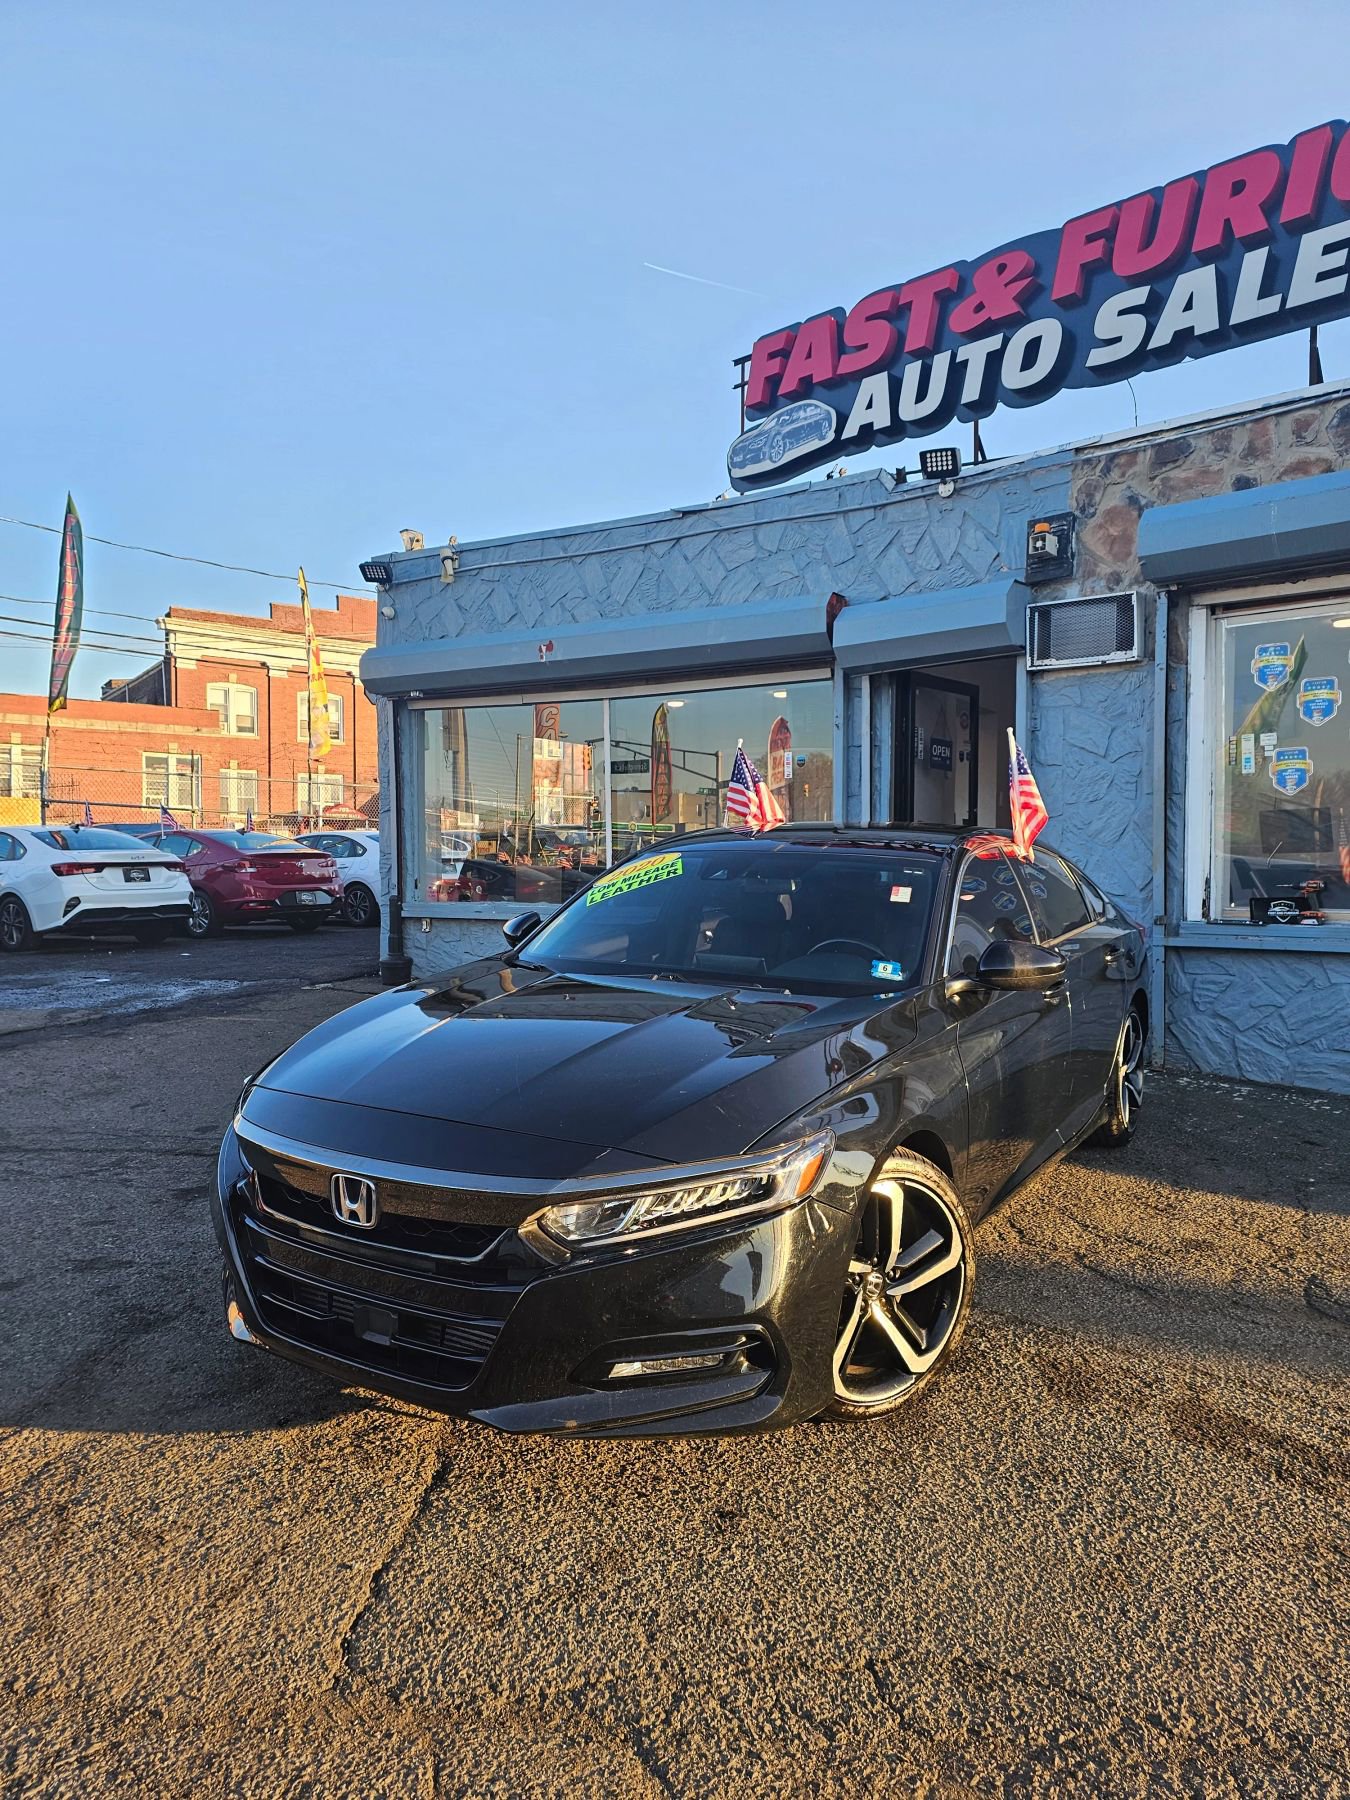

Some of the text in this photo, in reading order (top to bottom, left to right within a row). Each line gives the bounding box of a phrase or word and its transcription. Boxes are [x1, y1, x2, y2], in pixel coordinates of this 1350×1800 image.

[744, 267, 960, 407] FAST
[949, 250, 1039, 334] &
[840, 219, 1350, 440] AUTO SALE
[932, 744, 951, 758] OPEN
[588, 868, 679, 904] LEATHER
[589, 860, 679, 896] LOW MILEAGE
[607, 856, 666, 883] 2020
[882, 964, 888, 972] 6
